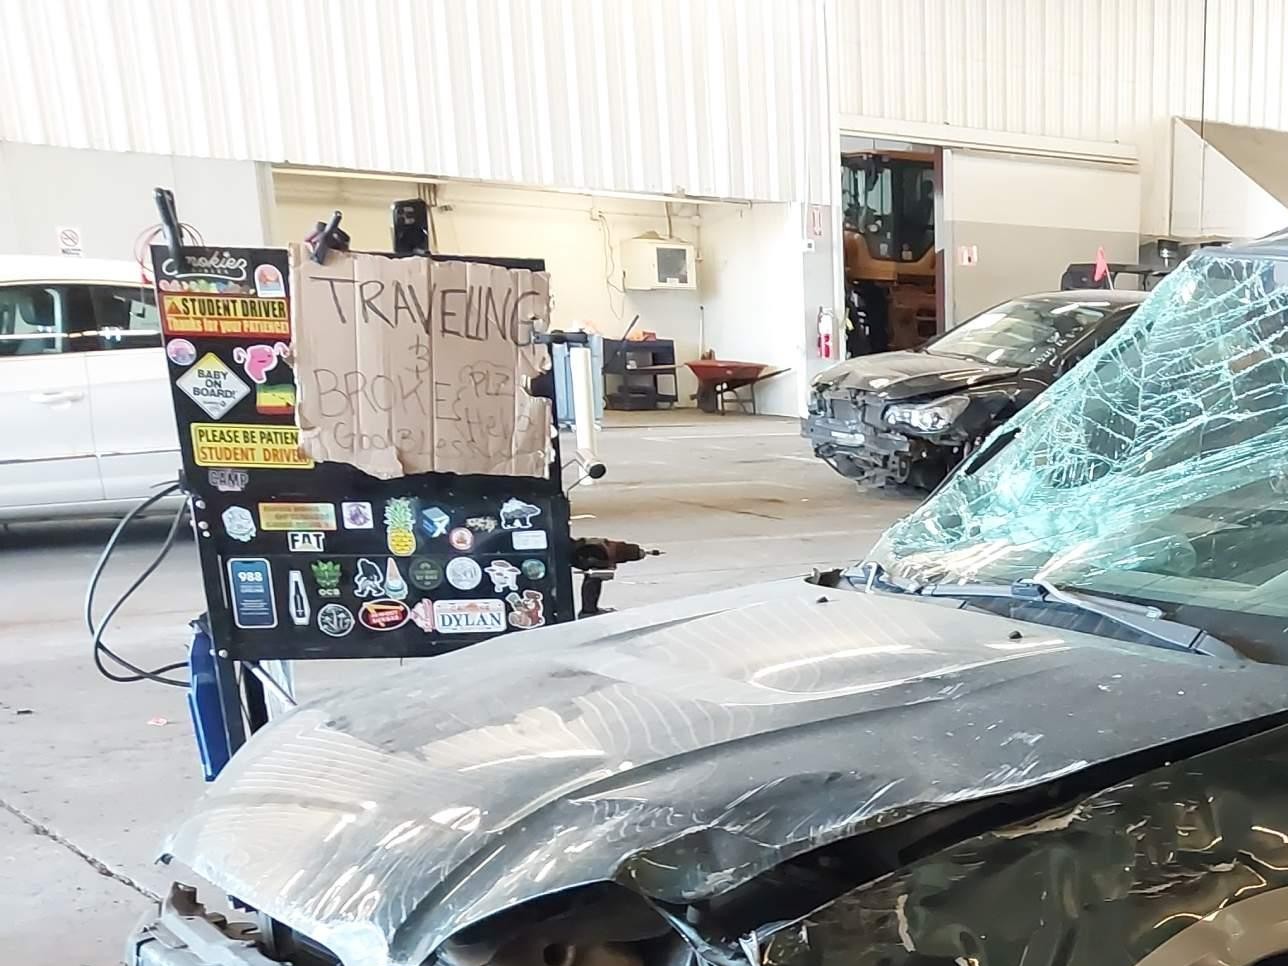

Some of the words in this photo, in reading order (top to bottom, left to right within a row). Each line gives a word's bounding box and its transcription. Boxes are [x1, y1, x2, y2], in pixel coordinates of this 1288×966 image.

[181, 297, 238, 317] STUDENT
[241, 299, 286, 318] DRIVER
[310, 276, 540, 353] TRAVELING
[197, 369, 229, 381] BABY
[205, 380, 222, 389] ON
[469, 370, 515, 398] PLZ
[192, 387, 236, 400] BOARD!
[313, 368, 461, 421] BROKE
[198, 429, 240, 444] PLEASE
[243, 431, 257, 444] BE
[260, 432, 299, 445] PATIEN
[201, 446, 256, 462] STUDENT
[209, 470, 248, 489] CAMP
[290, 533, 323, 550] FAT
[238, 571, 263, 582] 988
[440, 612, 501, 628] DYLAN
